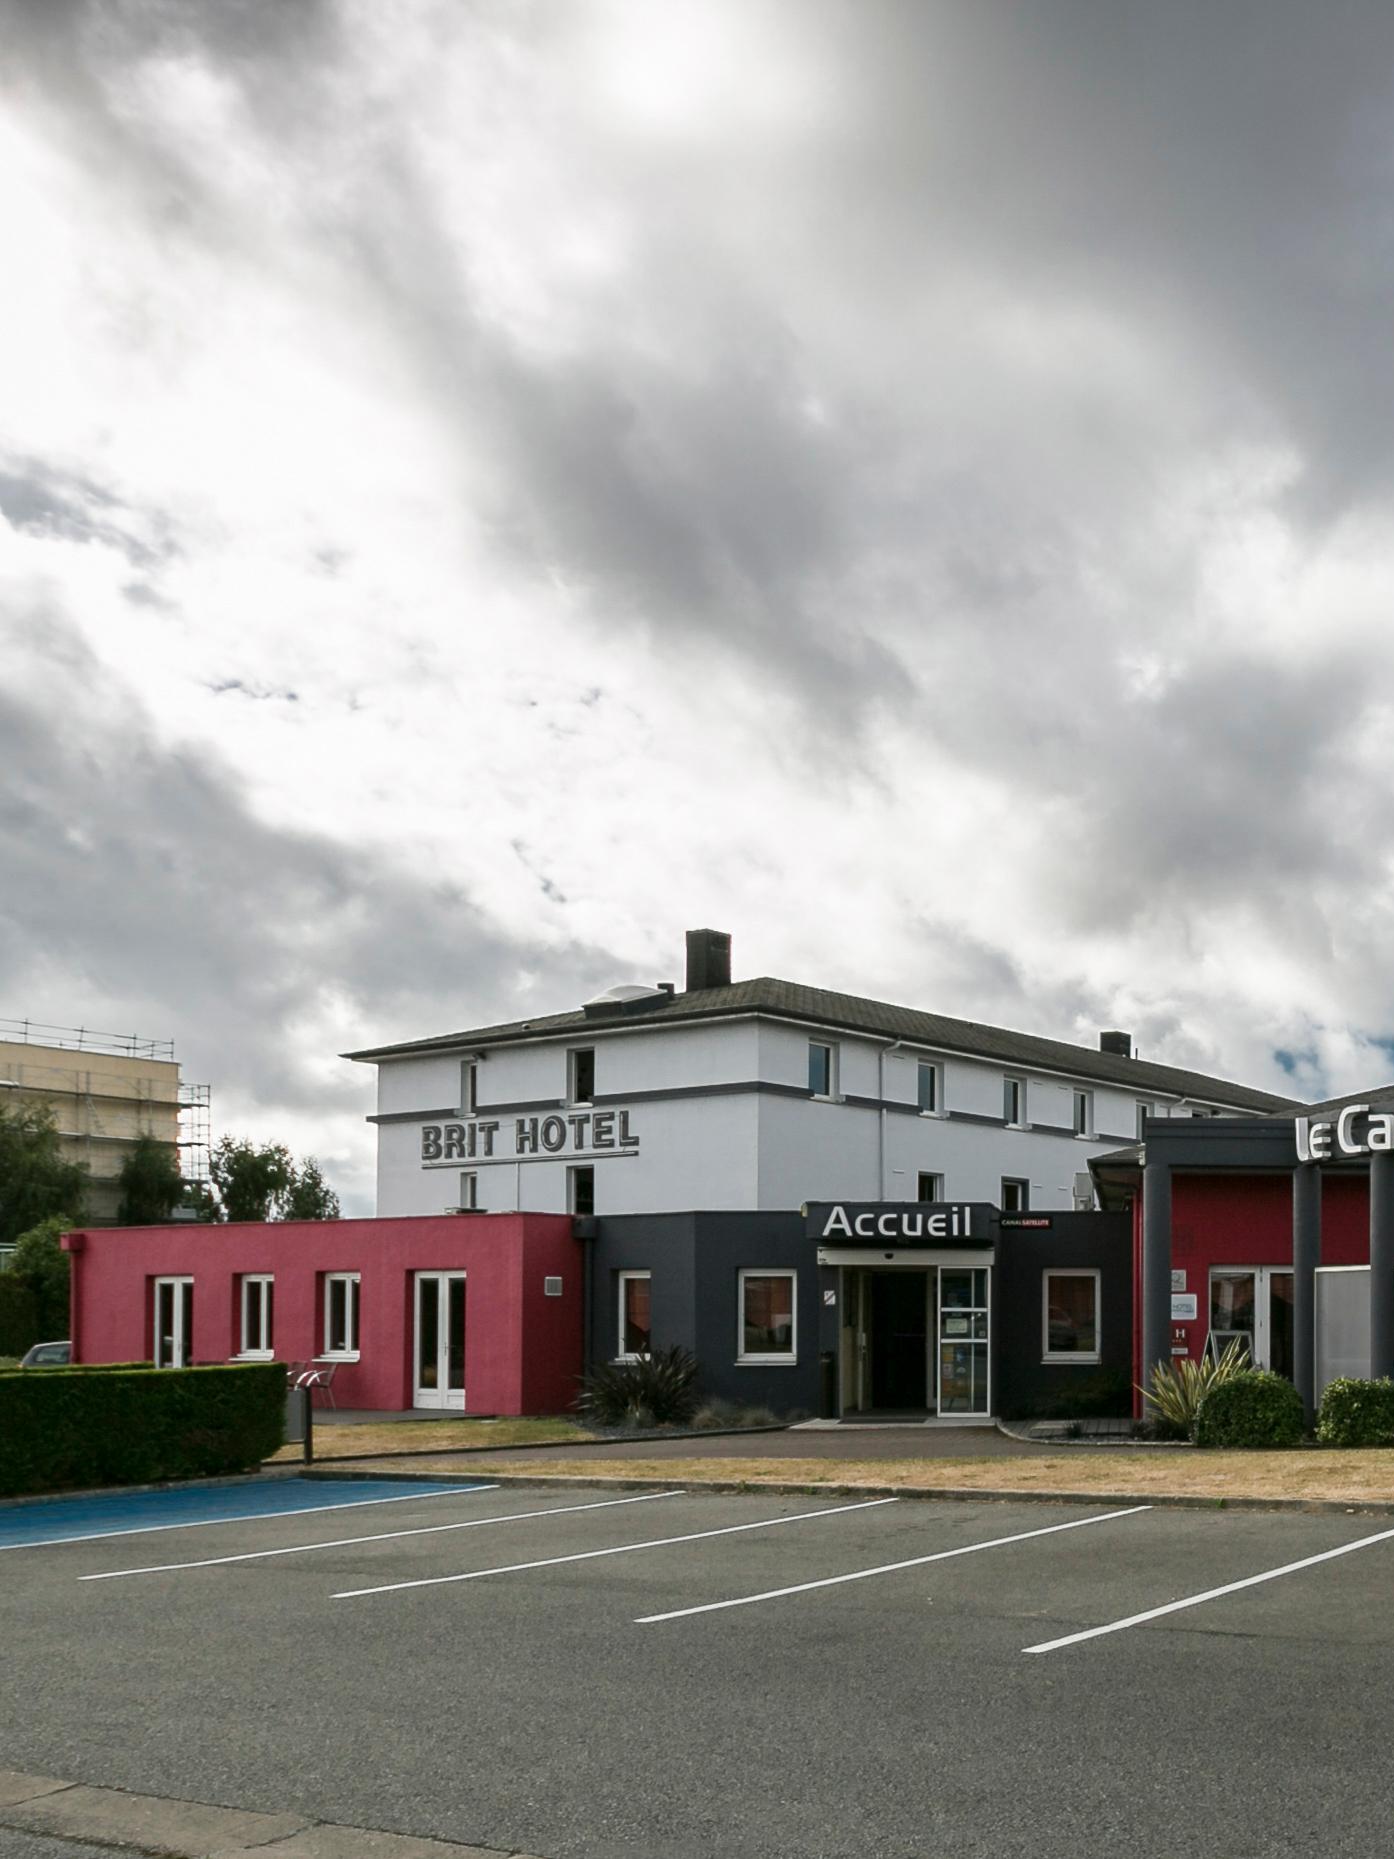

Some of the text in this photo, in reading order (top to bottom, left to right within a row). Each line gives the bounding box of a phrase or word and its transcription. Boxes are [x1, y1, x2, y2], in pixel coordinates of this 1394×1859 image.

[421, 1110, 640, 1160] BRIT HOTEL
[822, 1205, 971, 1237] Accueil
